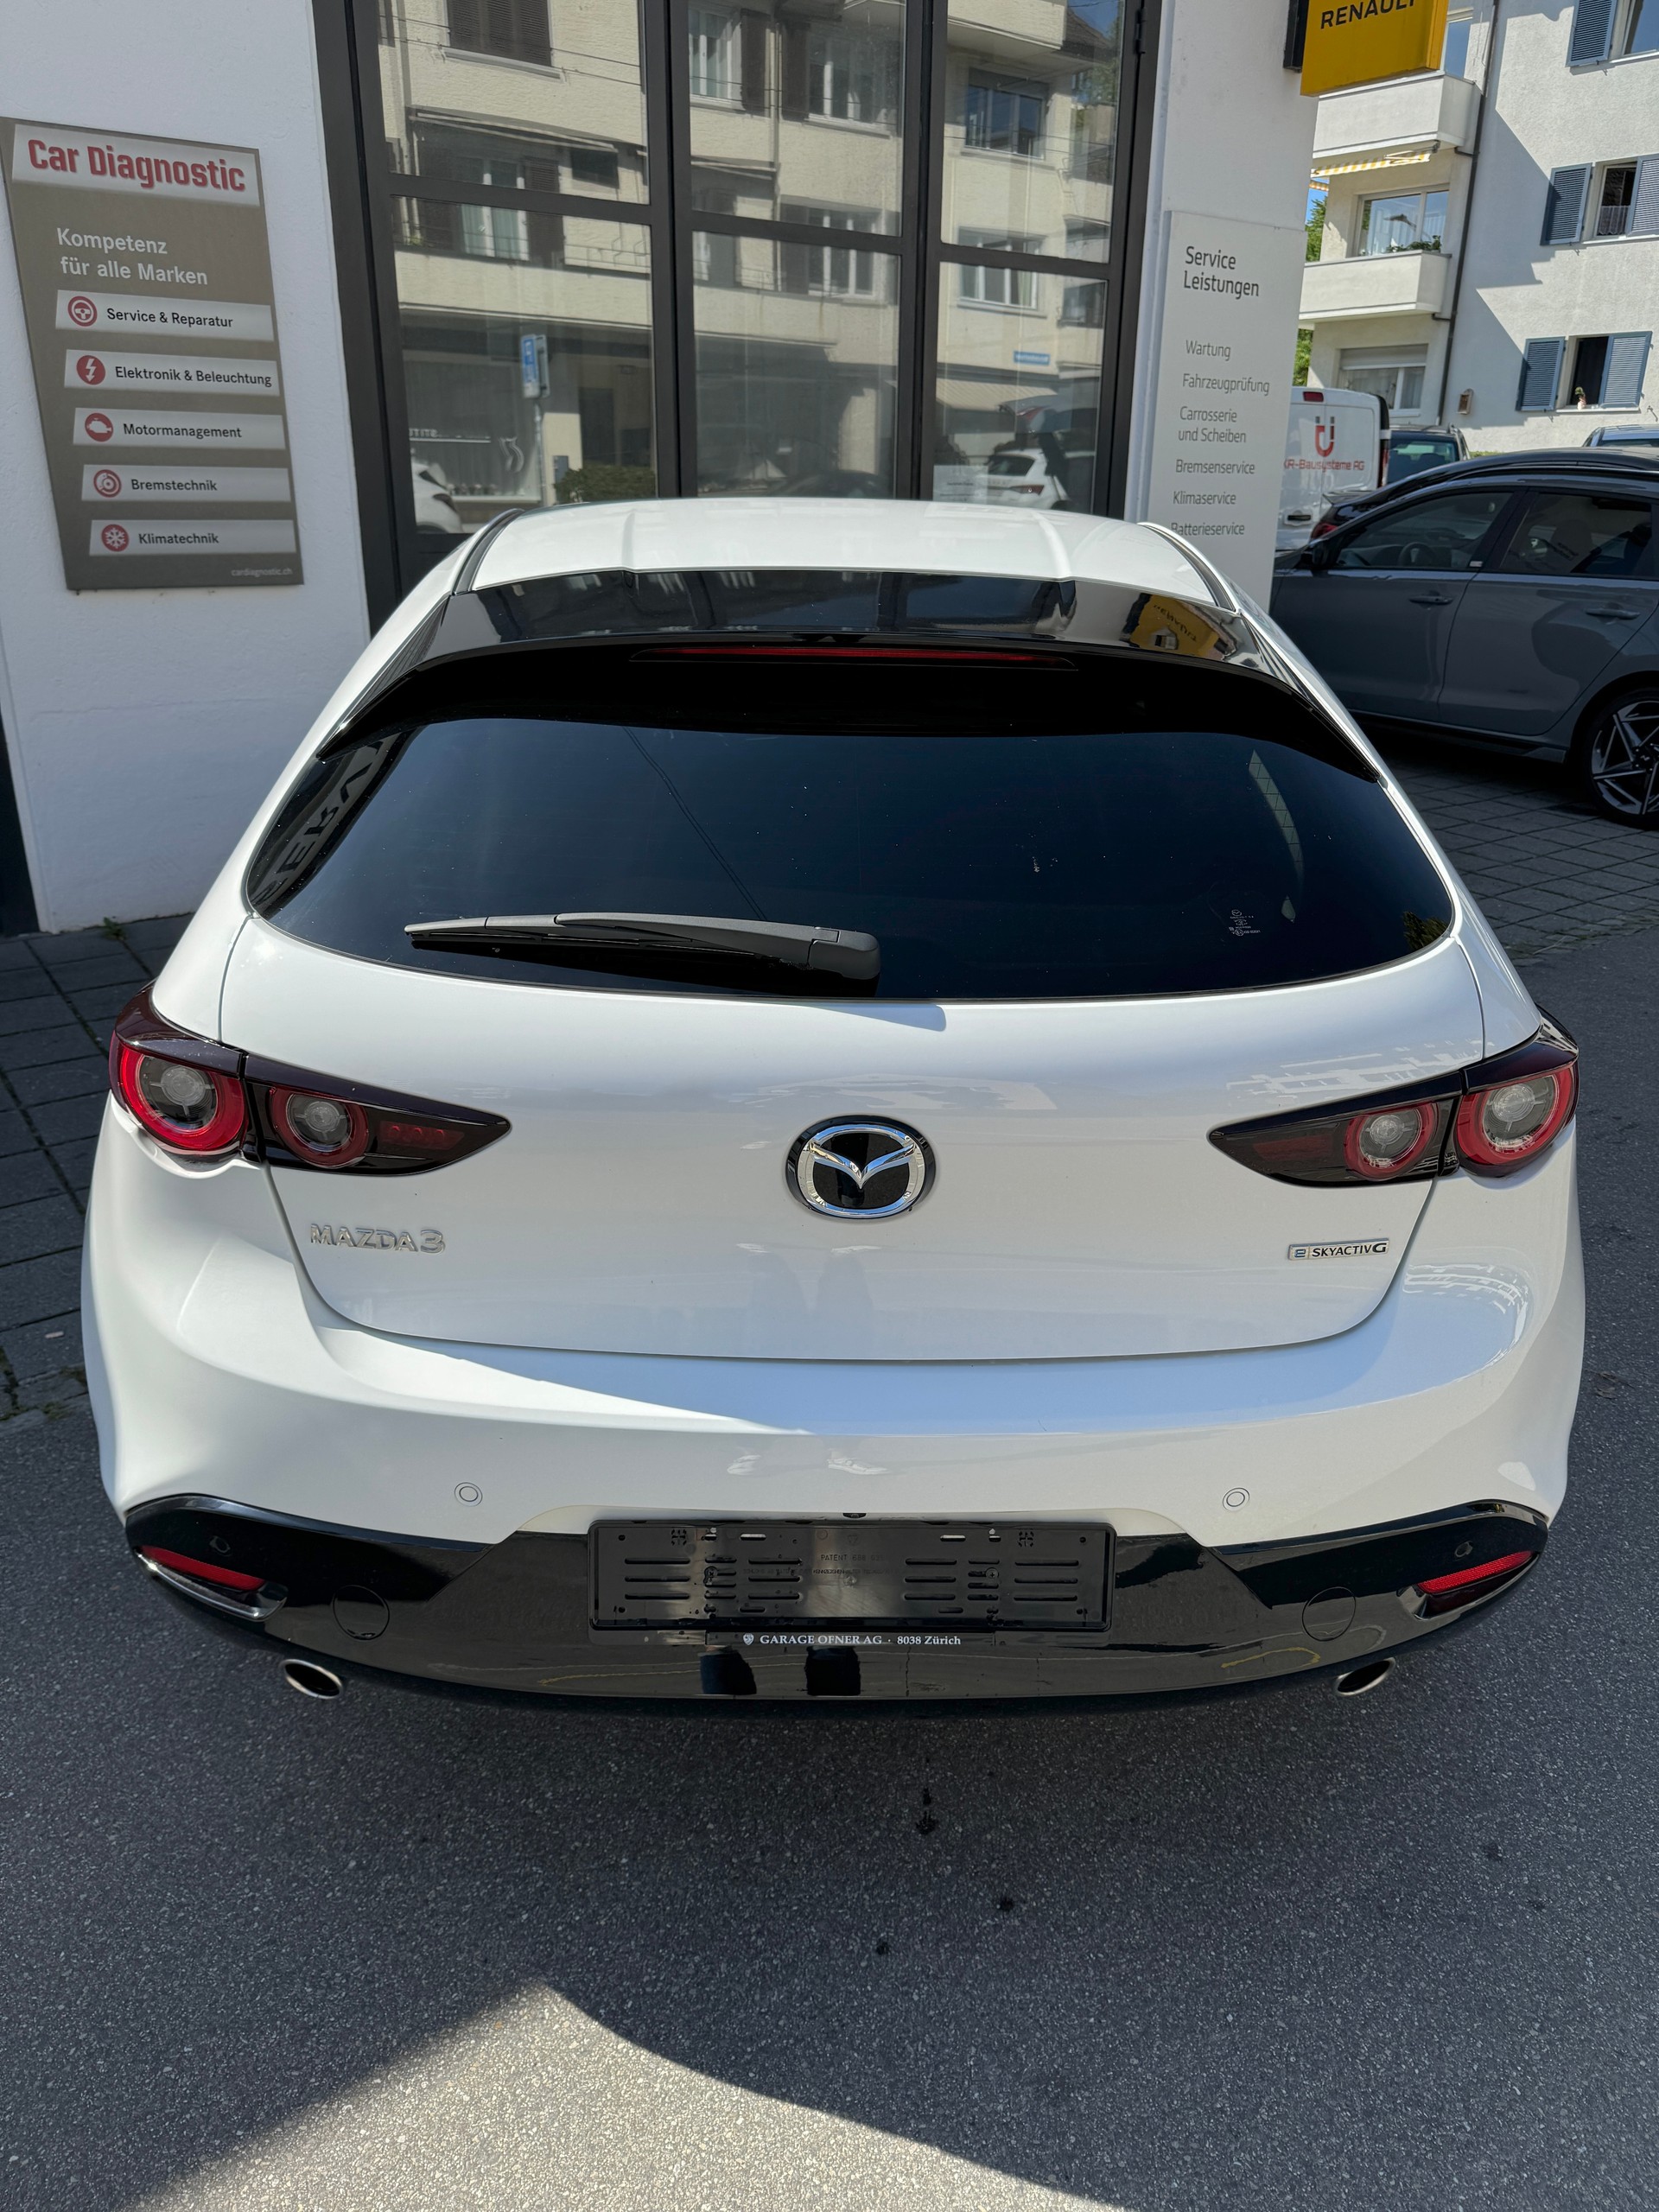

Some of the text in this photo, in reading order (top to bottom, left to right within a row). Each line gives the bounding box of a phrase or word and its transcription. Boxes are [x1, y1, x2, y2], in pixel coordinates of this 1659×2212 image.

[28, 139, 246, 191] Car Diagnostic
[56, 227, 168, 255] Kompetenz
[1185, 245, 1236, 270] Service
[60, 257, 208, 285] für alle Marken
[1183, 270, 1260, 300] Leistungen
[106, 308, 233, 328] Service & Reparatur
[1185, 340, 1231, 362] Wartung
[115, 366, 272, 388] Elektronik & Beleuchtung
[1182, 373, 1270, 396] Fahrzeugprüfung
[1179, 406, 1237, 423] Carrosserie
[123, 423, 242, 440] Motormanagement
[1178, 428, 1247, 443] und Scheiben
[1175, 459, 1255, 475] Bremsenservice
[1353, 461, 1365, 470] AG
[131, 479, 218, 493] Bremstechnik
[1173, 491, 1236, 505] Klimaservice
[1170, 522, 1245, 537] Batterieservice
[138, 532, 219, 545] Klimatechnik
[760, 1635, 961, 1645] GARAGE OFNER AG 8038 Zürich
